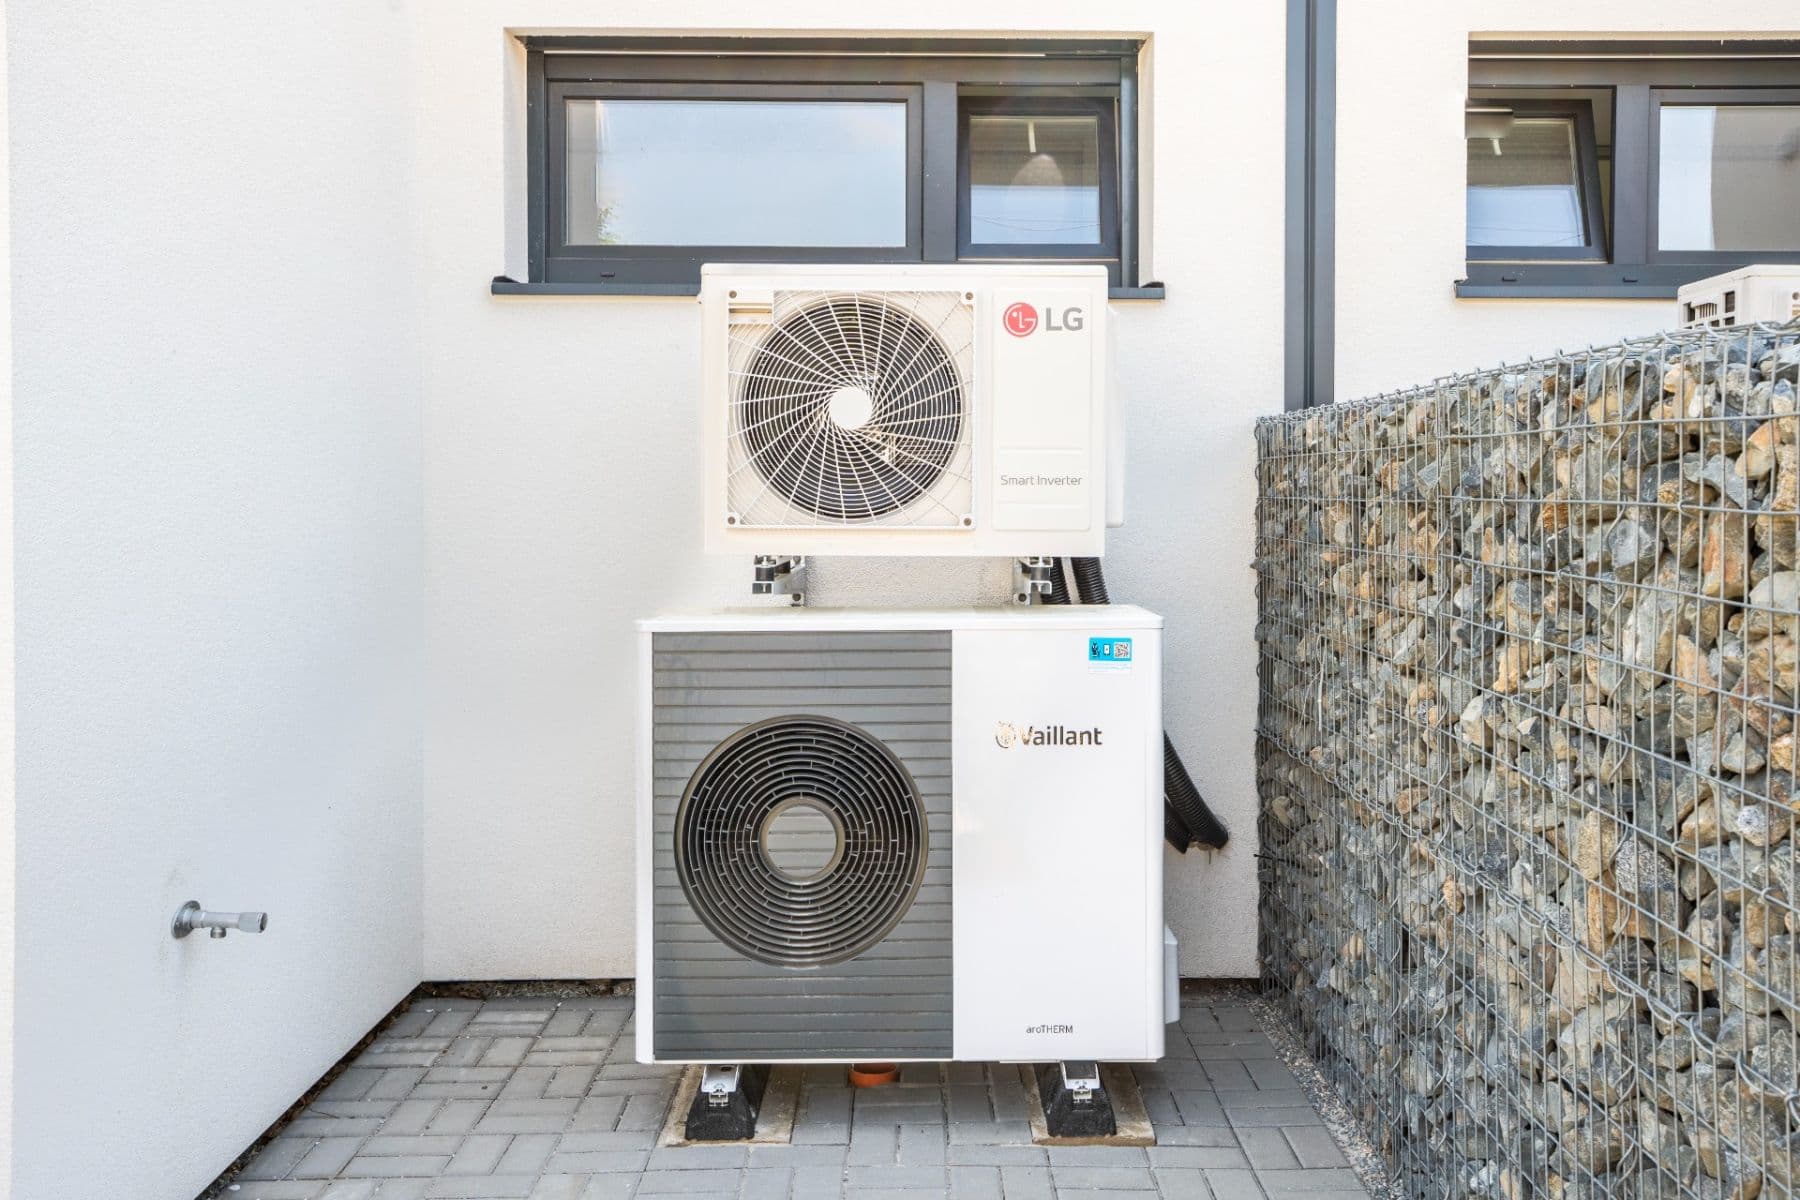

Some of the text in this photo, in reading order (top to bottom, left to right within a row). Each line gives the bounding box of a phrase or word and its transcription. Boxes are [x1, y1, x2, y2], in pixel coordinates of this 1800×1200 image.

[1046, 307, 1083, 331] LG
[1000, 475, 1083, 486] Smart Inverter
[1020, 725, 1103, 746] Vaillant
[1026, 1024, 1073, 1034] aroTHERM
